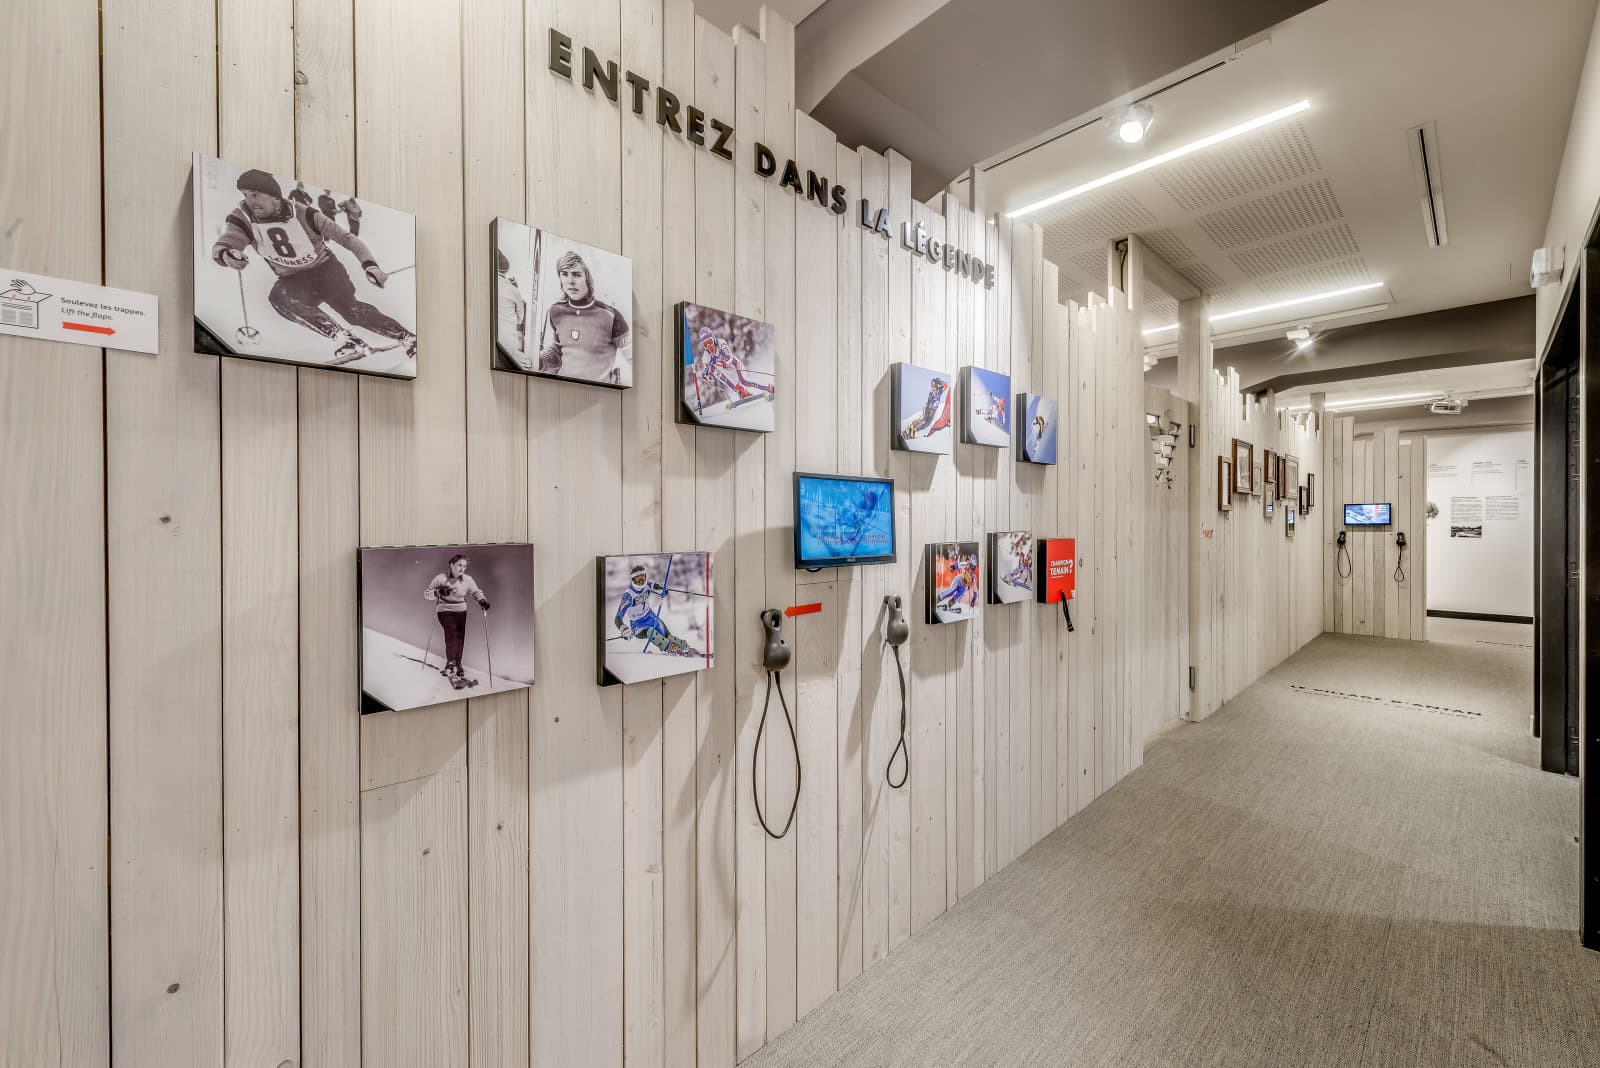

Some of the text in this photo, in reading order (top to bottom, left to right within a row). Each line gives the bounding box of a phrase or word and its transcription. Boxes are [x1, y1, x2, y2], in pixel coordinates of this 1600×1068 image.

[548, 27, 995, 290] ENTREZ DANS LA LÉGENDE
[267, 227, 296, 257] 8
[60, 298, 146, 316] Soulevez les trappes.
[60, 307, 114, 321] Lift the flaps.
